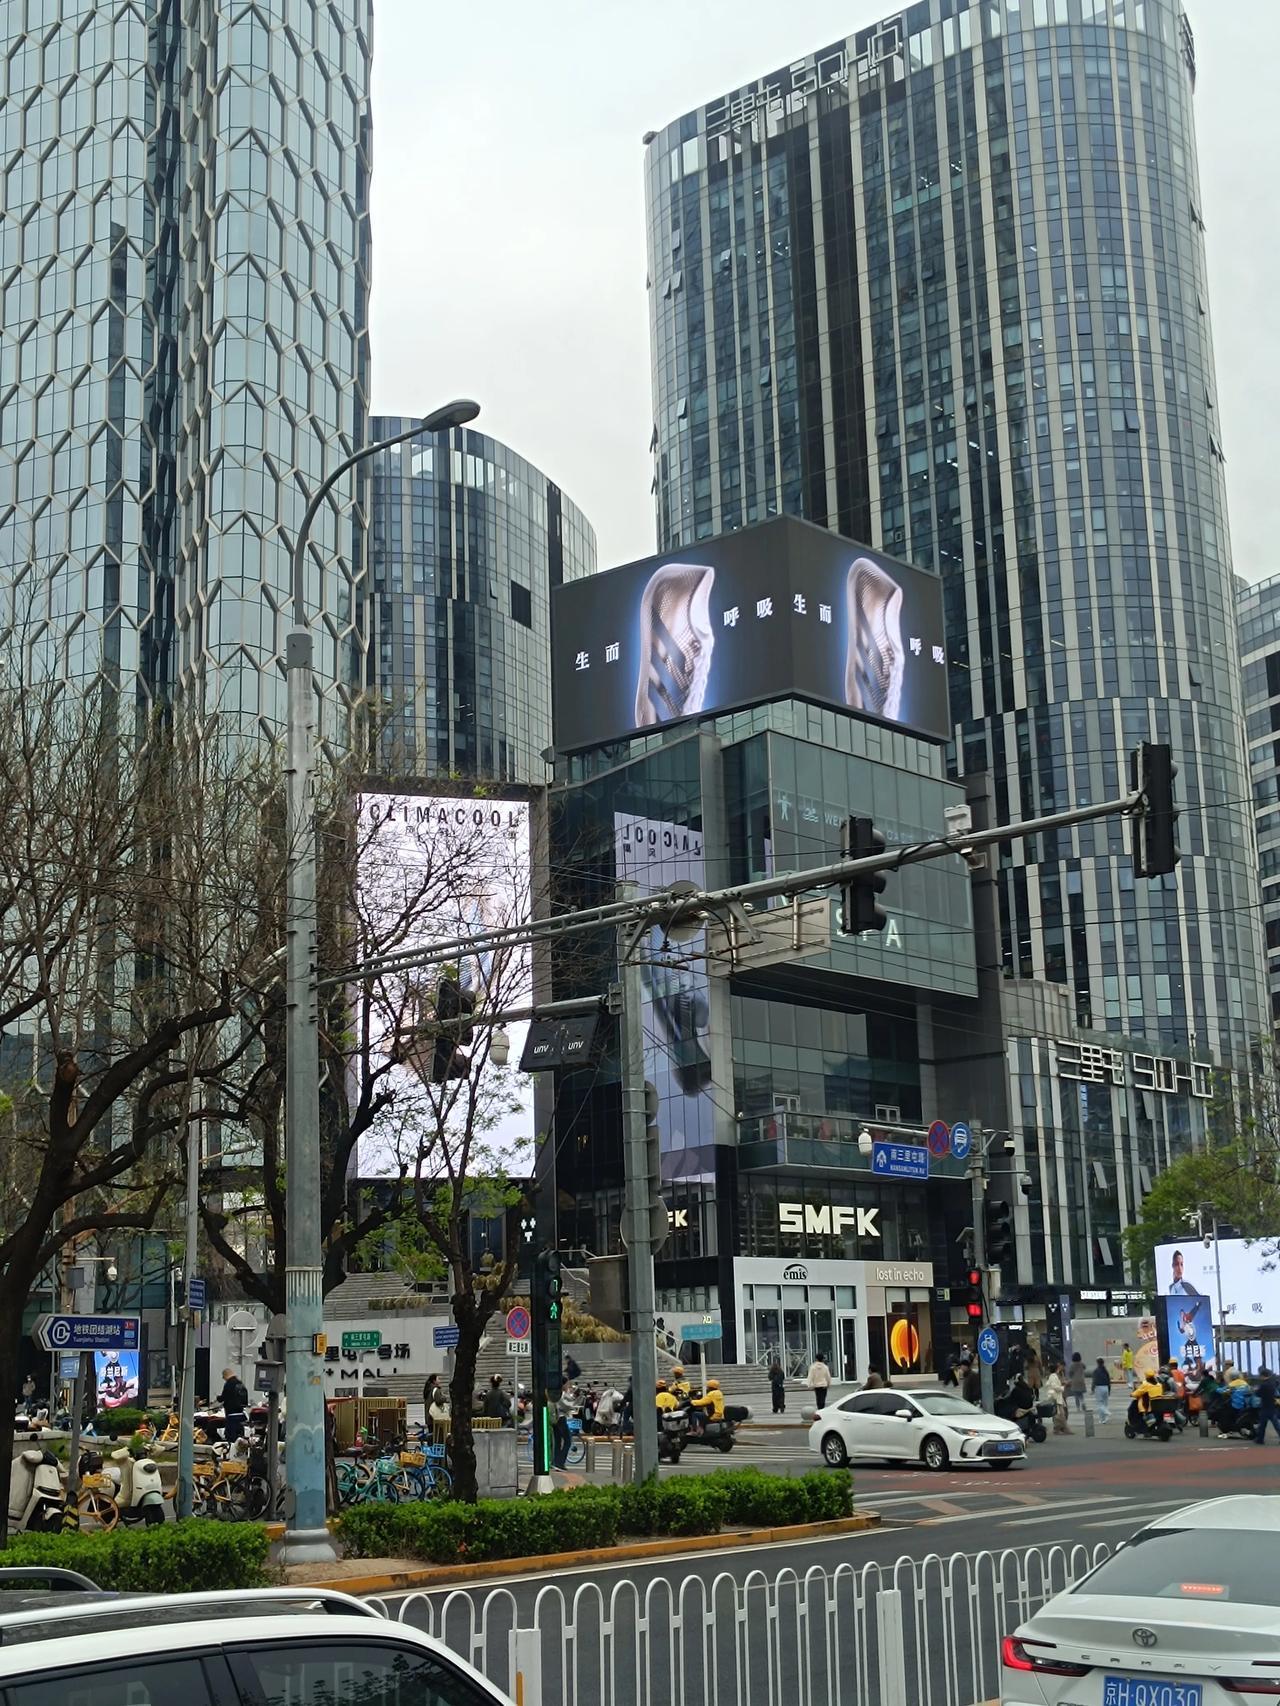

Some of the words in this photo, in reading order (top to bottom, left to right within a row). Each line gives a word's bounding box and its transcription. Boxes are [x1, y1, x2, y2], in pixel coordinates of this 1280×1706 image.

[723, 596, 773, 628] 呼吸
[1133, 1052, 1213, 1099] SOHO
[778, 1203, 881, 1237] SMFK
[783, 1268, 808, 1280] emis
[876, 1266, 893, 1281] lost
[894, 1266, 902, 1281] in
[903, 1267, 924, 1282] echo
